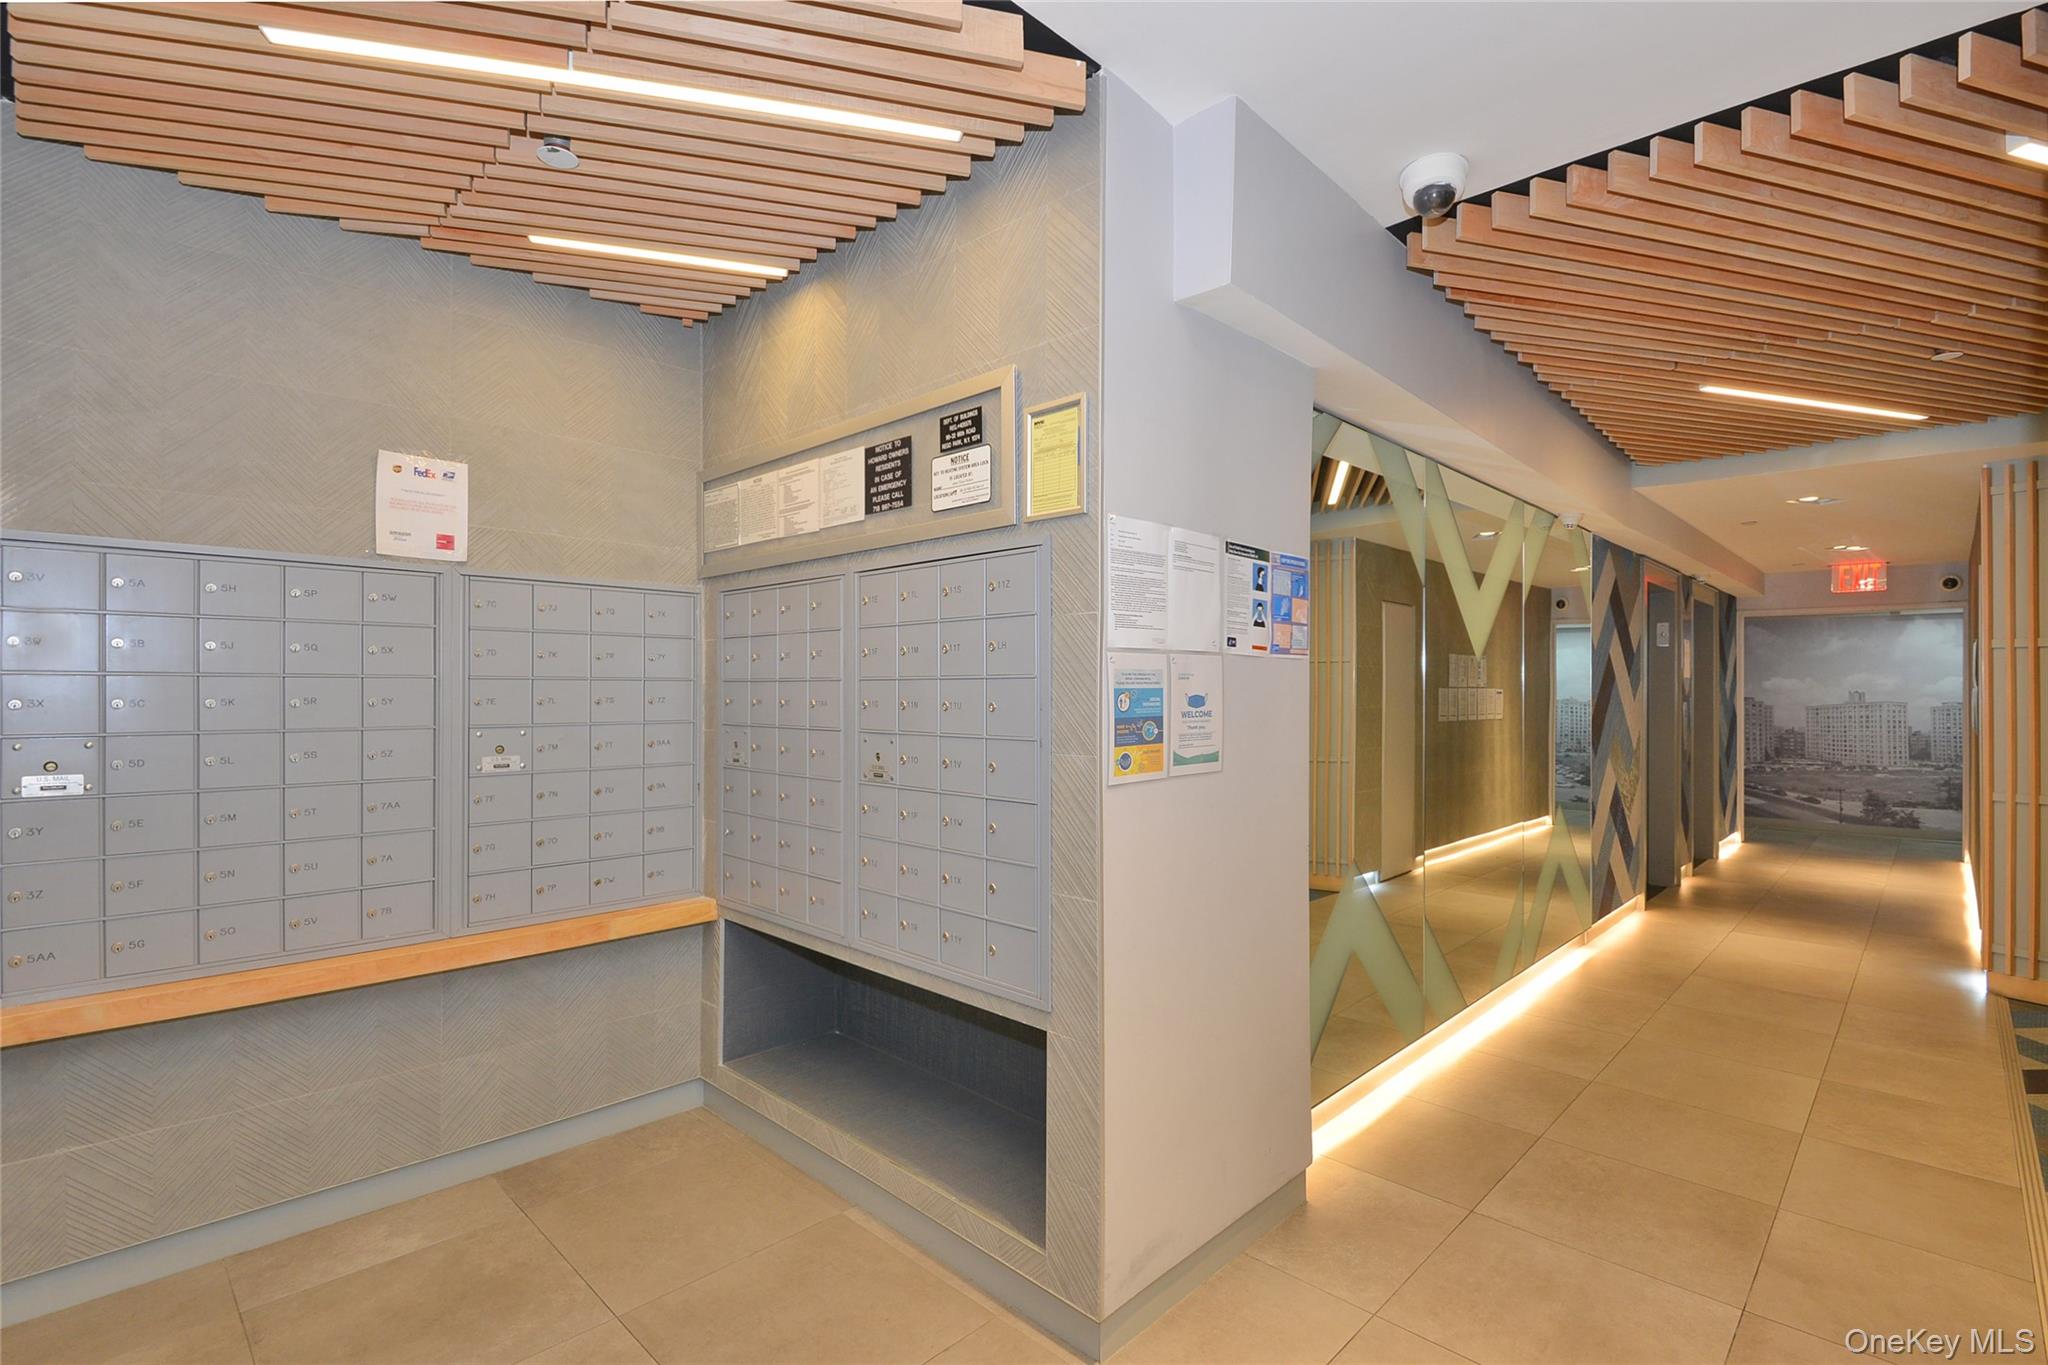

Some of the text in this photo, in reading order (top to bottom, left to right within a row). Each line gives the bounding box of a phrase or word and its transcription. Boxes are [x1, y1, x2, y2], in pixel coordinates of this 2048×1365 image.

[875, 442, 893, 453] NOTICE
[868, 448, 909, 464] HOWARD OWNERS
[950, 453, 969, 464] NOTICE
[875, 460, 901, 472] RESIDENTS
[414, 467, 436, 479] FedEx
[881, 472, 894, 481] CASE
[878, 479, 907, 492] EMERGENCY
[872, 491, 904, 503] PLEASE CALL
[26, 572, 45, 582] 3V
[1839, 565, 1882, 591] EXIT
[129, 579, 145, 587] 5A
[24, 637, 42, 646] 3W
[26, 700, 44, 708] 3X
[129, 700, 145, 708] 5C
[1181, 710, 1212, 718] WELCOME
[381, 801, 400, 810] 7AA
[304, 808, 317, 816] 5T
[220, 814, 236, 823] 5M
[128, 819, 144, 828] 5E
[26, 827, 43, 836] 3Y
[220, 870, 235, 878] 5N
[128, 880, 144, 889] 5F
[26, 890, 43, 899] 3Z
[304, 918, 318, 926] 5V
[128, 940, 145, 949] 5G
[27, 952, 56, 962] 5AA
